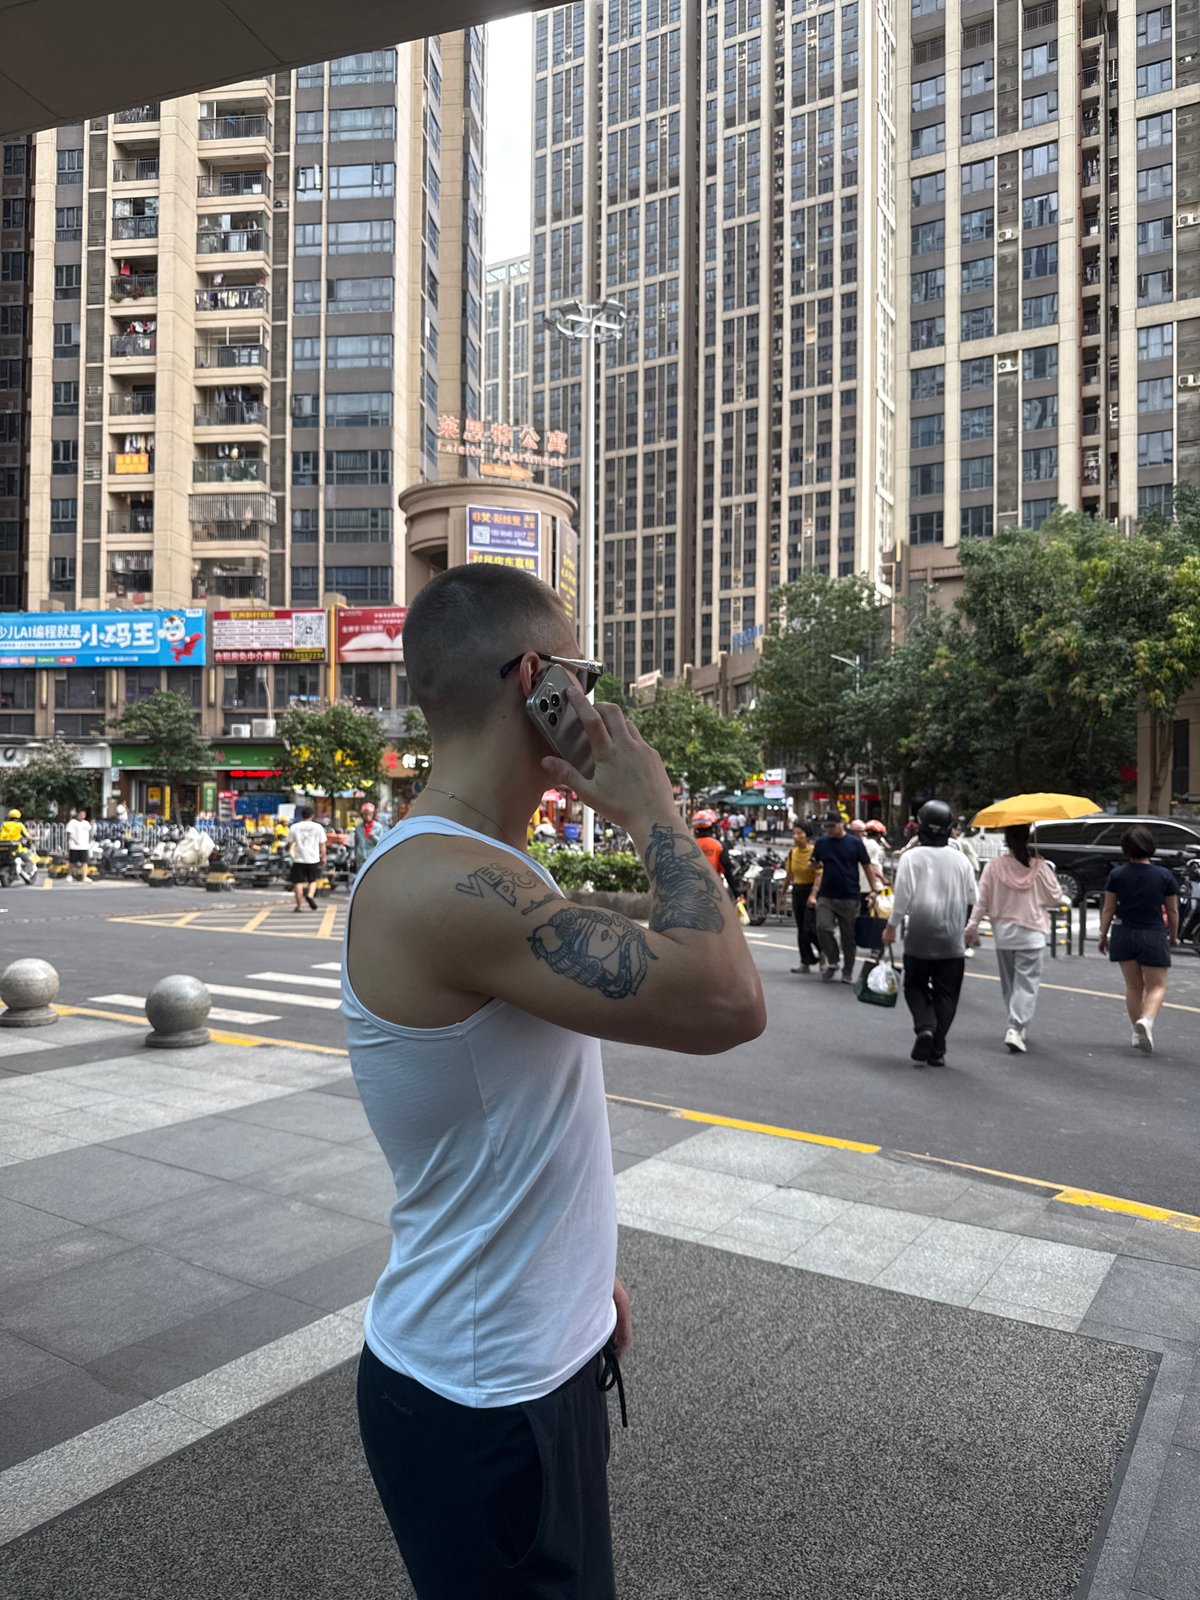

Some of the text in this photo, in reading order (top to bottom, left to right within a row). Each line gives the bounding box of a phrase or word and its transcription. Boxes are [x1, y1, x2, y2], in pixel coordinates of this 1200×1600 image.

[493, 448, 565, 468] Apartment
[81, 622, 155, 649] 小码王
